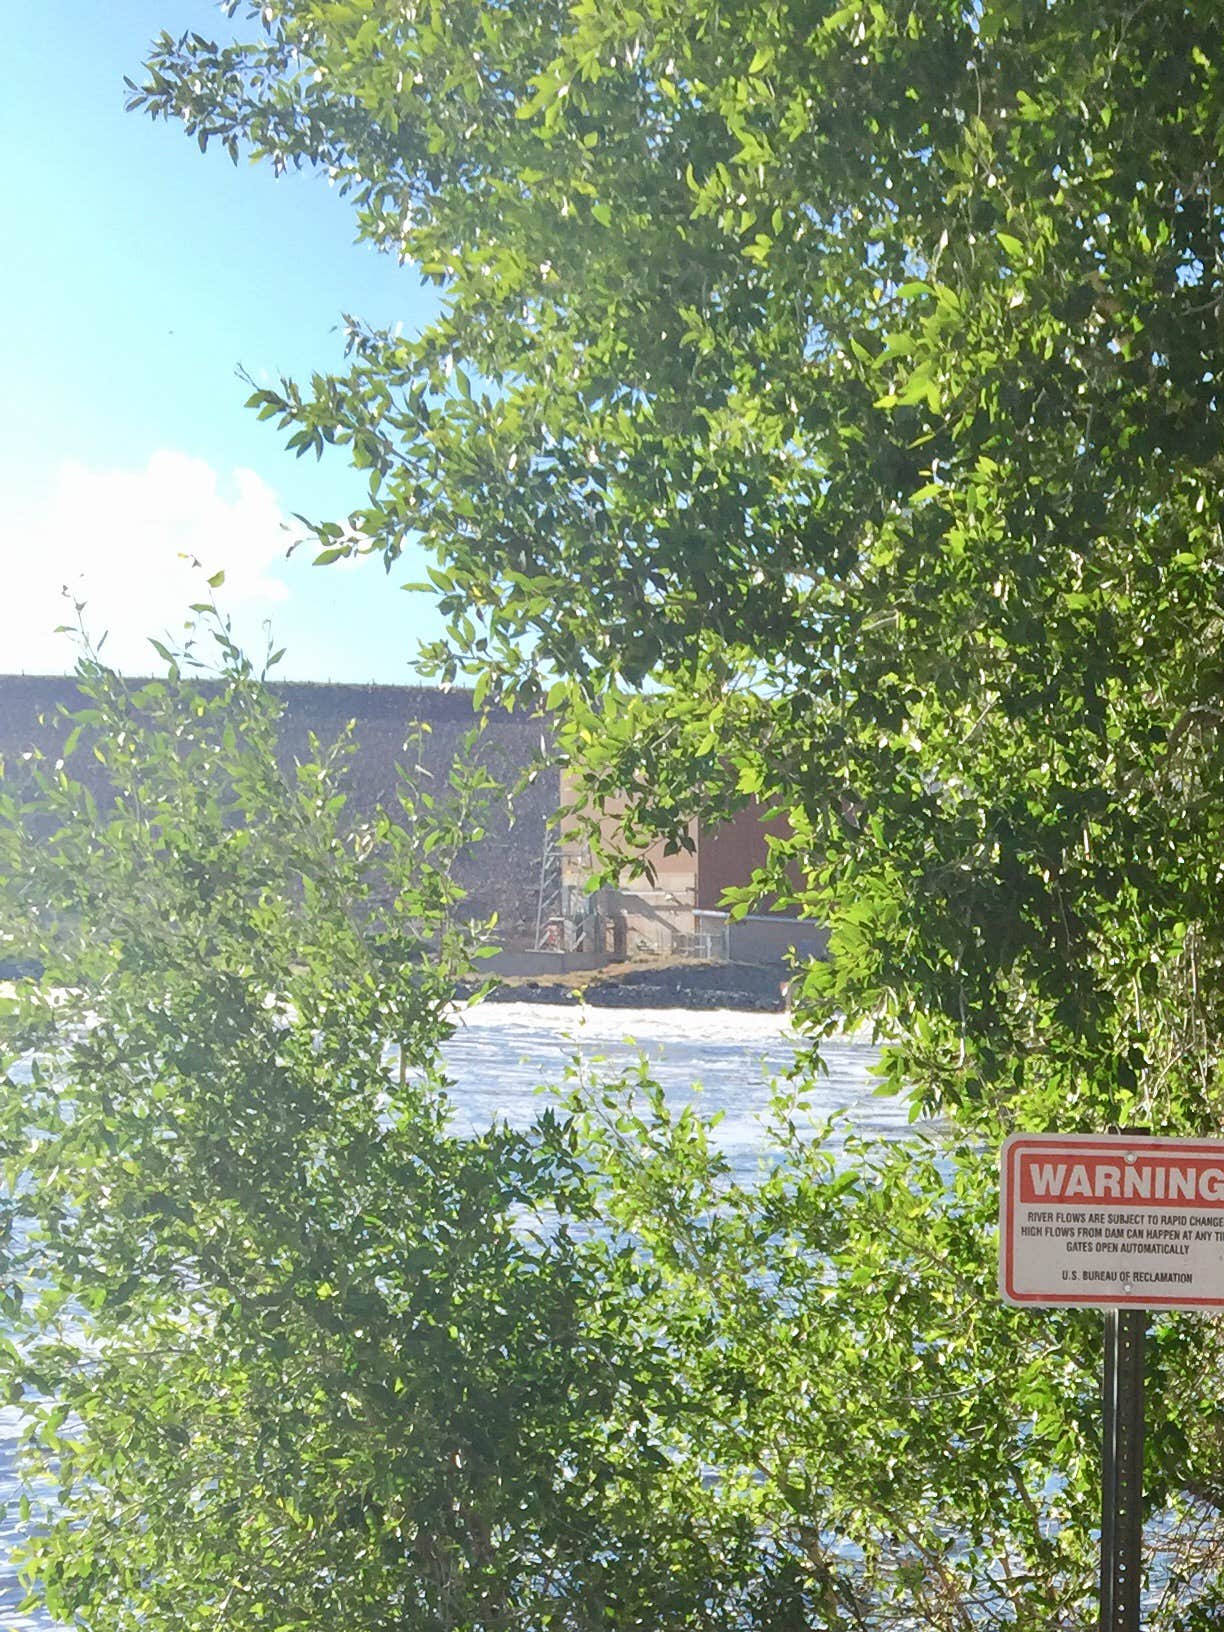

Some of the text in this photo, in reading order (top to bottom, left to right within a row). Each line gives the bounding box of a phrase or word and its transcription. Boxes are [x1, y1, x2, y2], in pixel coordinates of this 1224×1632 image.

[1028, 1212, 1053, 1222] RIVER
[1056, 1213, 1086, 1223] FLOWS
[1088, 1214, 1105, 1223] ARE
[1107, 1214, 1144, 1225] SUBJECT
[1148, 1215, 1158, 1225] TO
[1161, 1216, 1187, 1226] RAPID
[1021, 1227, 1043, 1237] HIGH
[1045, 1228, 1075, 1237] FLOWS
[1078, 1229, 1102, 1238] FROM
[1105, 1229, 1124, 1238] DAM
[1127, 1230, 1144, 1239] CAN
[1146, 1230, 1180, 1240] HAPPEN
[1182, 1231, 1193, 1241] AT
[1195, 1232, 1212, 1241] ANY
[1066, 1242, 1189, 1254] GATES OPEN AUTOMATICALLY
[1062, 1271, 1192, 1283] U.S. BUREAU OF RECLAMATION
